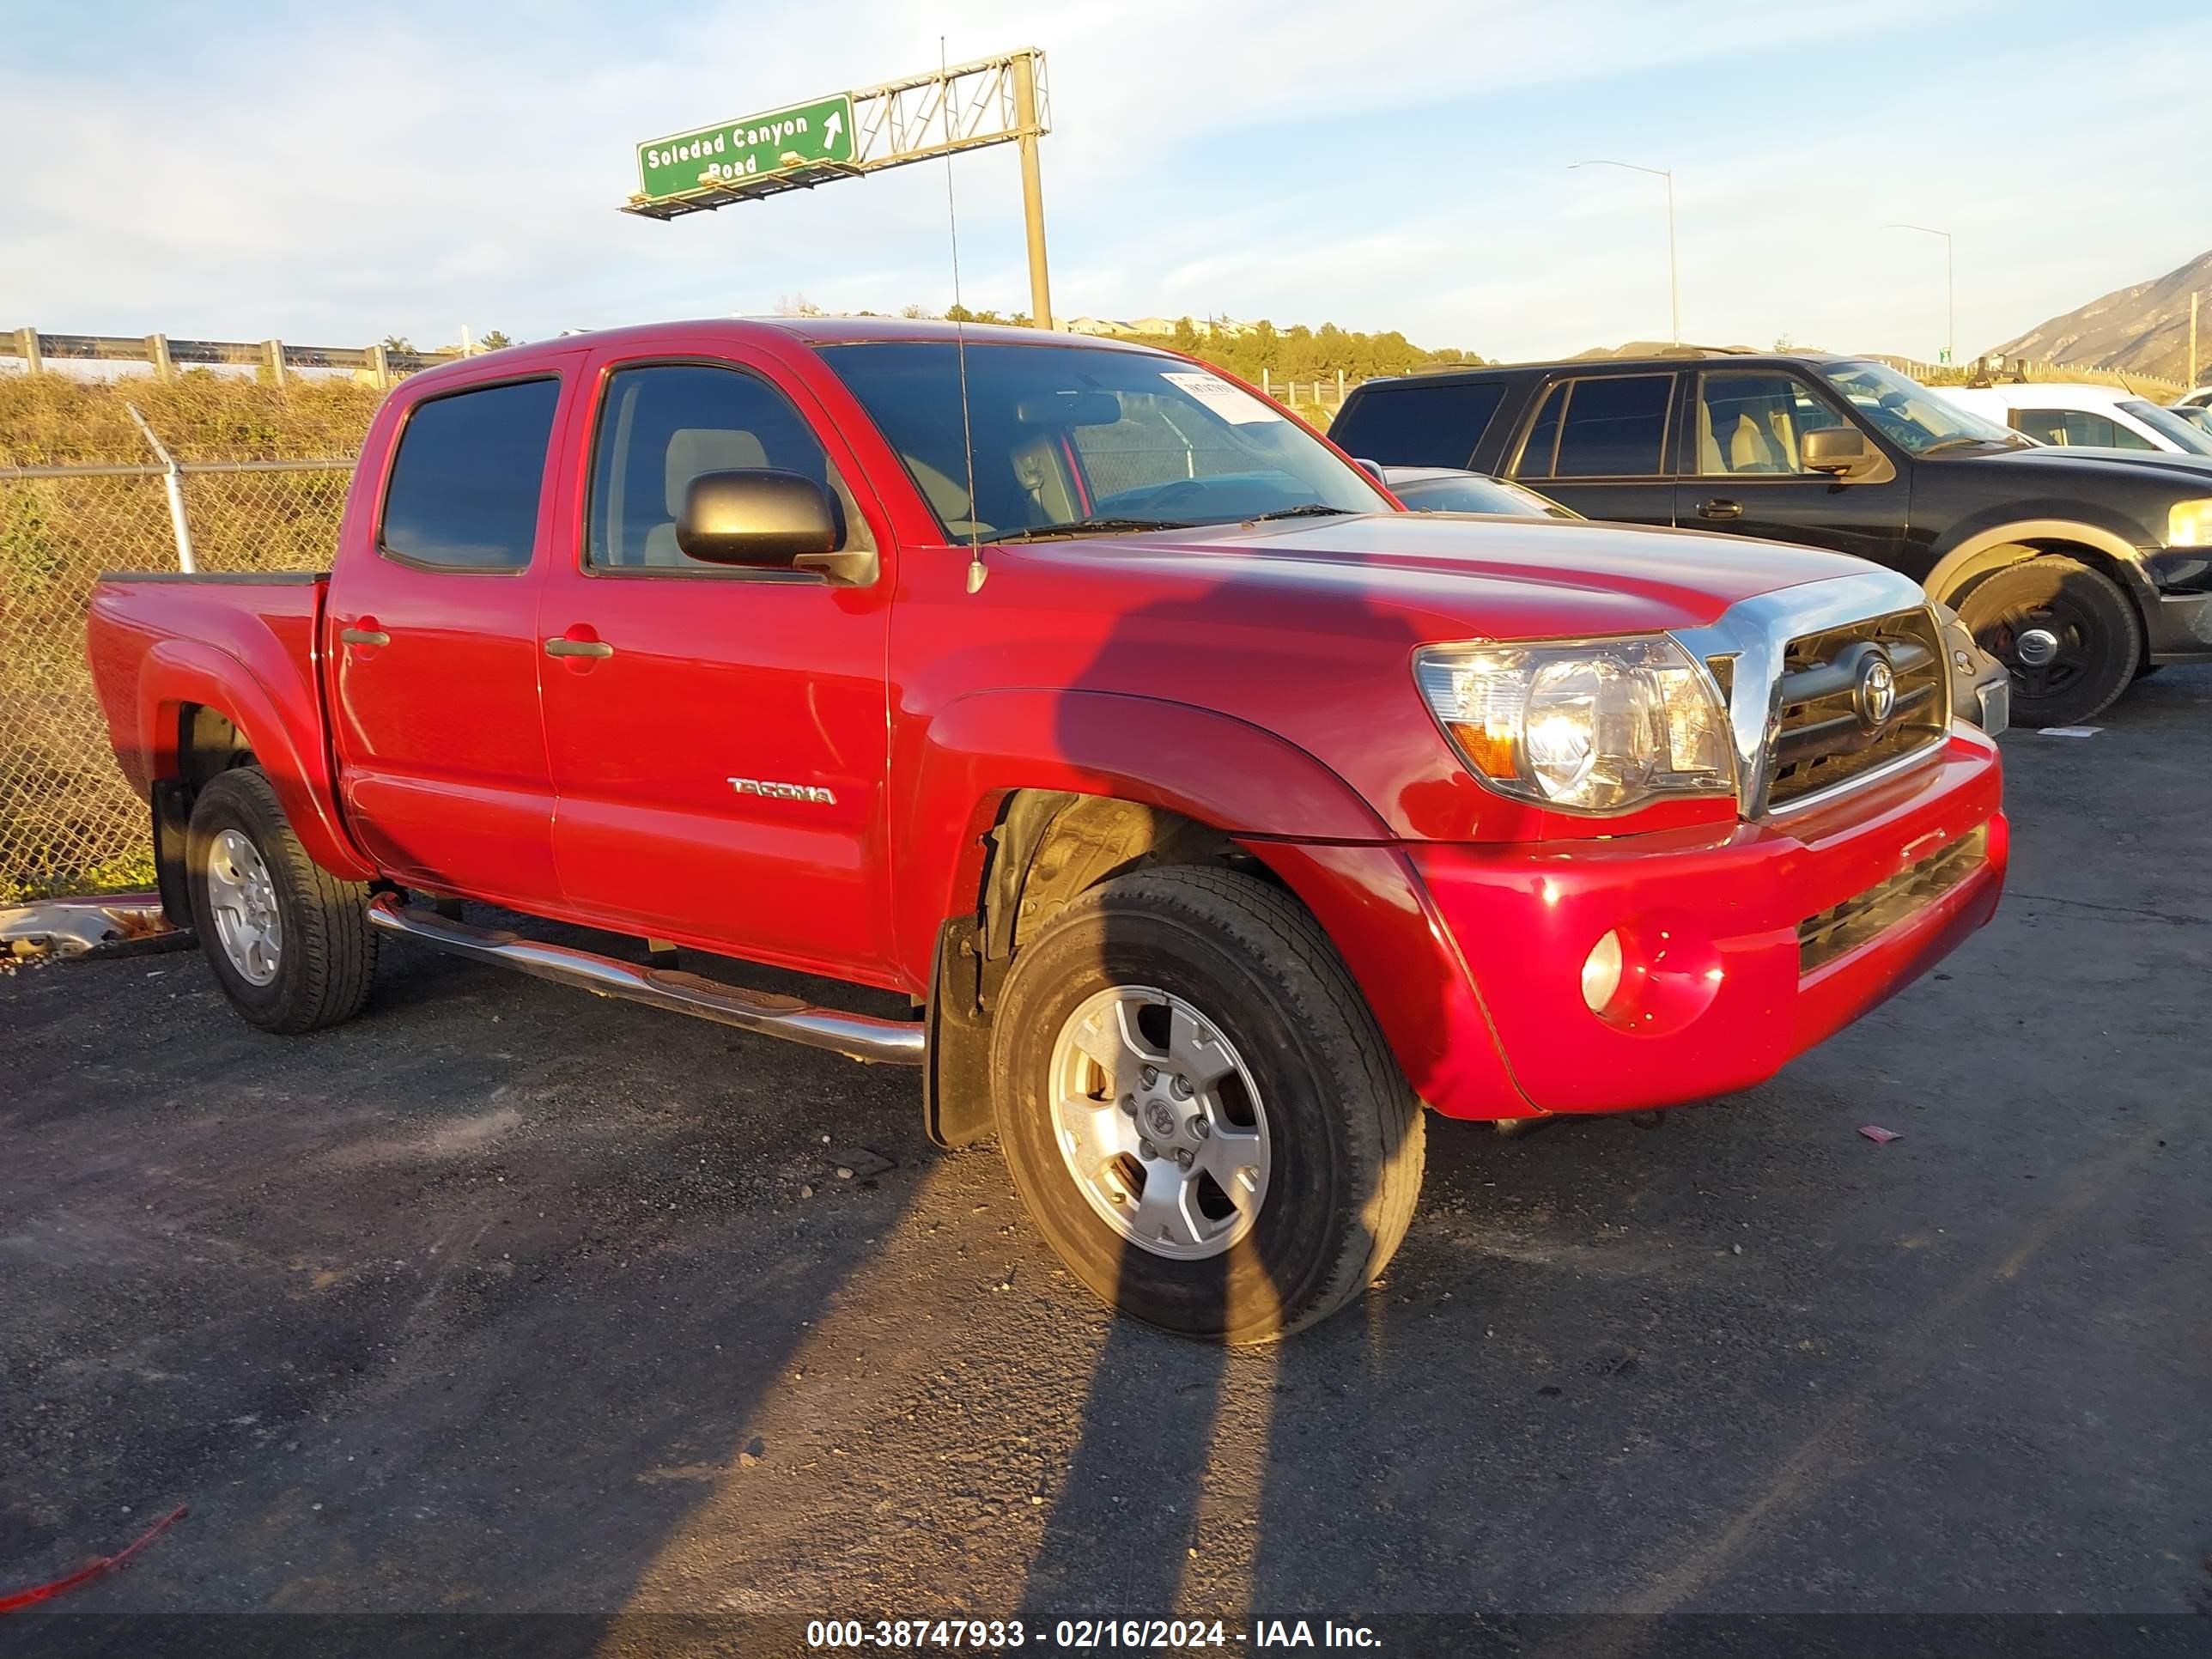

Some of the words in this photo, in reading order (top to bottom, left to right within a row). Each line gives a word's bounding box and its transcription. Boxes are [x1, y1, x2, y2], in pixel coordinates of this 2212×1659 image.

[647, 133, 725, 169] Soledad
[732, 117, 808, 147] Canyon
[726, 777, 837, 805] TACOMA
